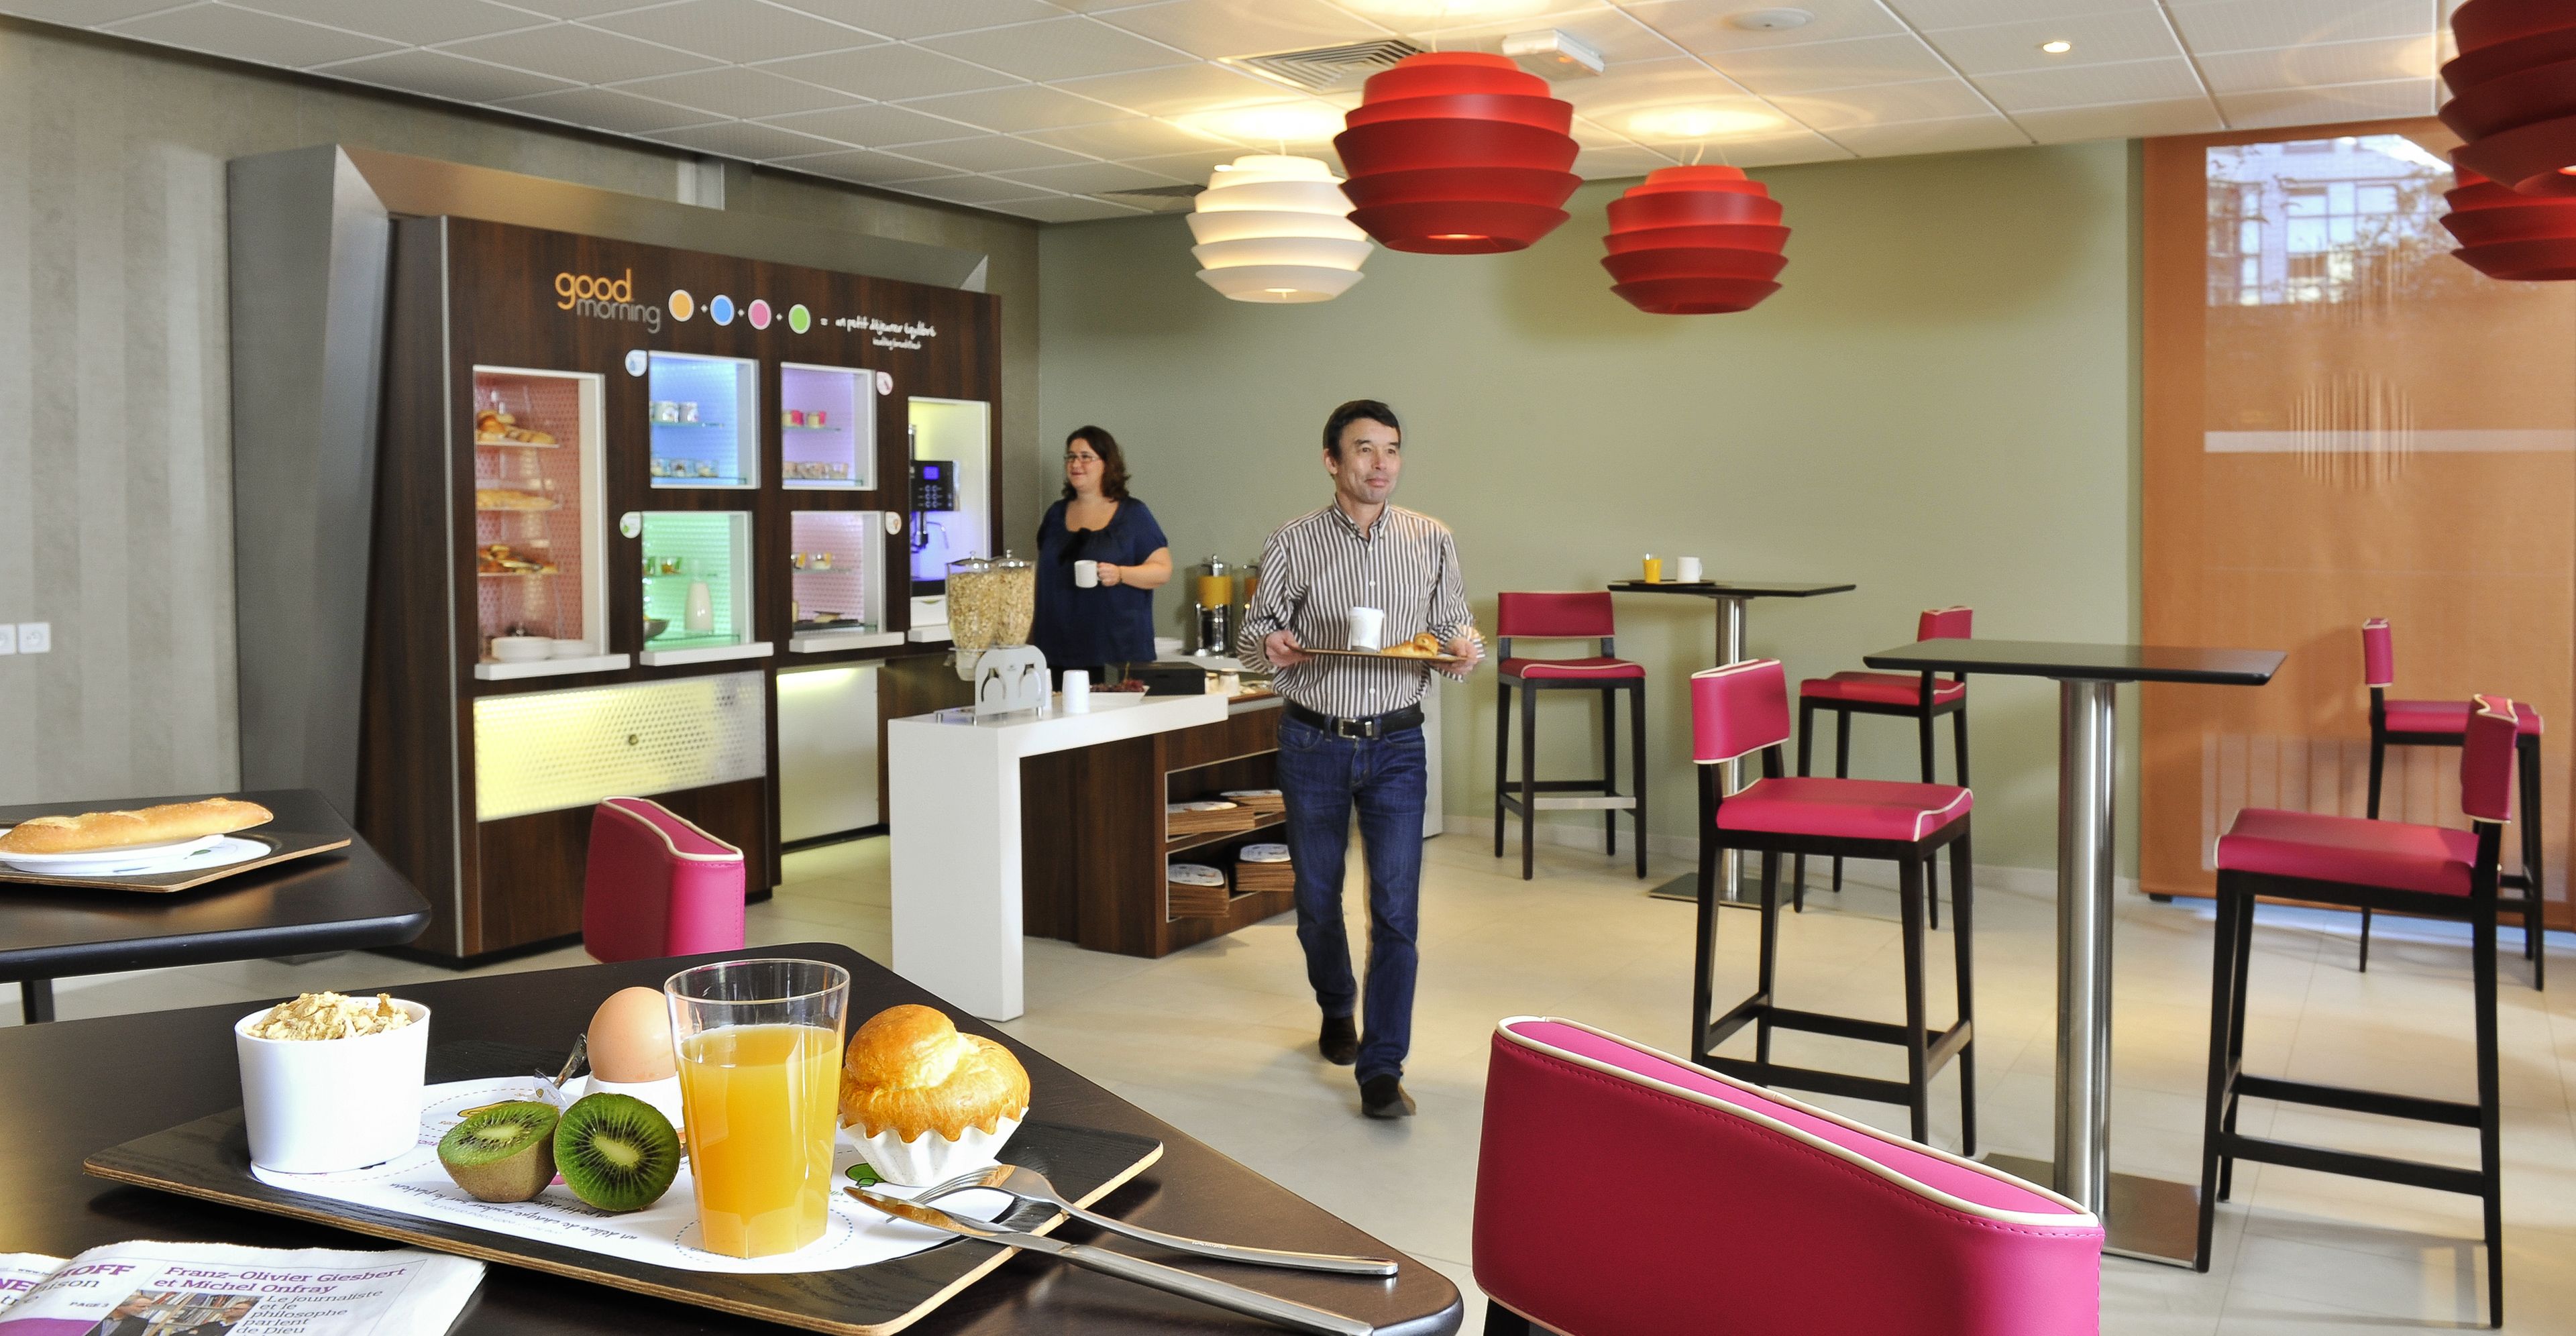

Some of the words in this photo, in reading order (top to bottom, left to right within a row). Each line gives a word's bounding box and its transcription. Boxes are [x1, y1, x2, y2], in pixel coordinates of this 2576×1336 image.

[555, 268, 632, 310] good
[576, 298, 661, 334] morning
[389, 1183, 439, 1196] plateau
[513, 1212, 561, 1225] chaque
[164, 1266, 313, 1282] Franz-Olivier
[317, 1268, 407, 1282] Giesbert
[154, 1279, 178, 1288] et
[180, 1279, 257, 1291] Michel
[260, 1284, 337, 1294] Onfray
[266, 1295, 288, 1303] Le
[289, 1290, 383, 1304] journaliste
[250, 1309, 347, 1319] philosophe
[242, 1318, 310, 1327] parlent
[236, 1326, 258, 1334] de
